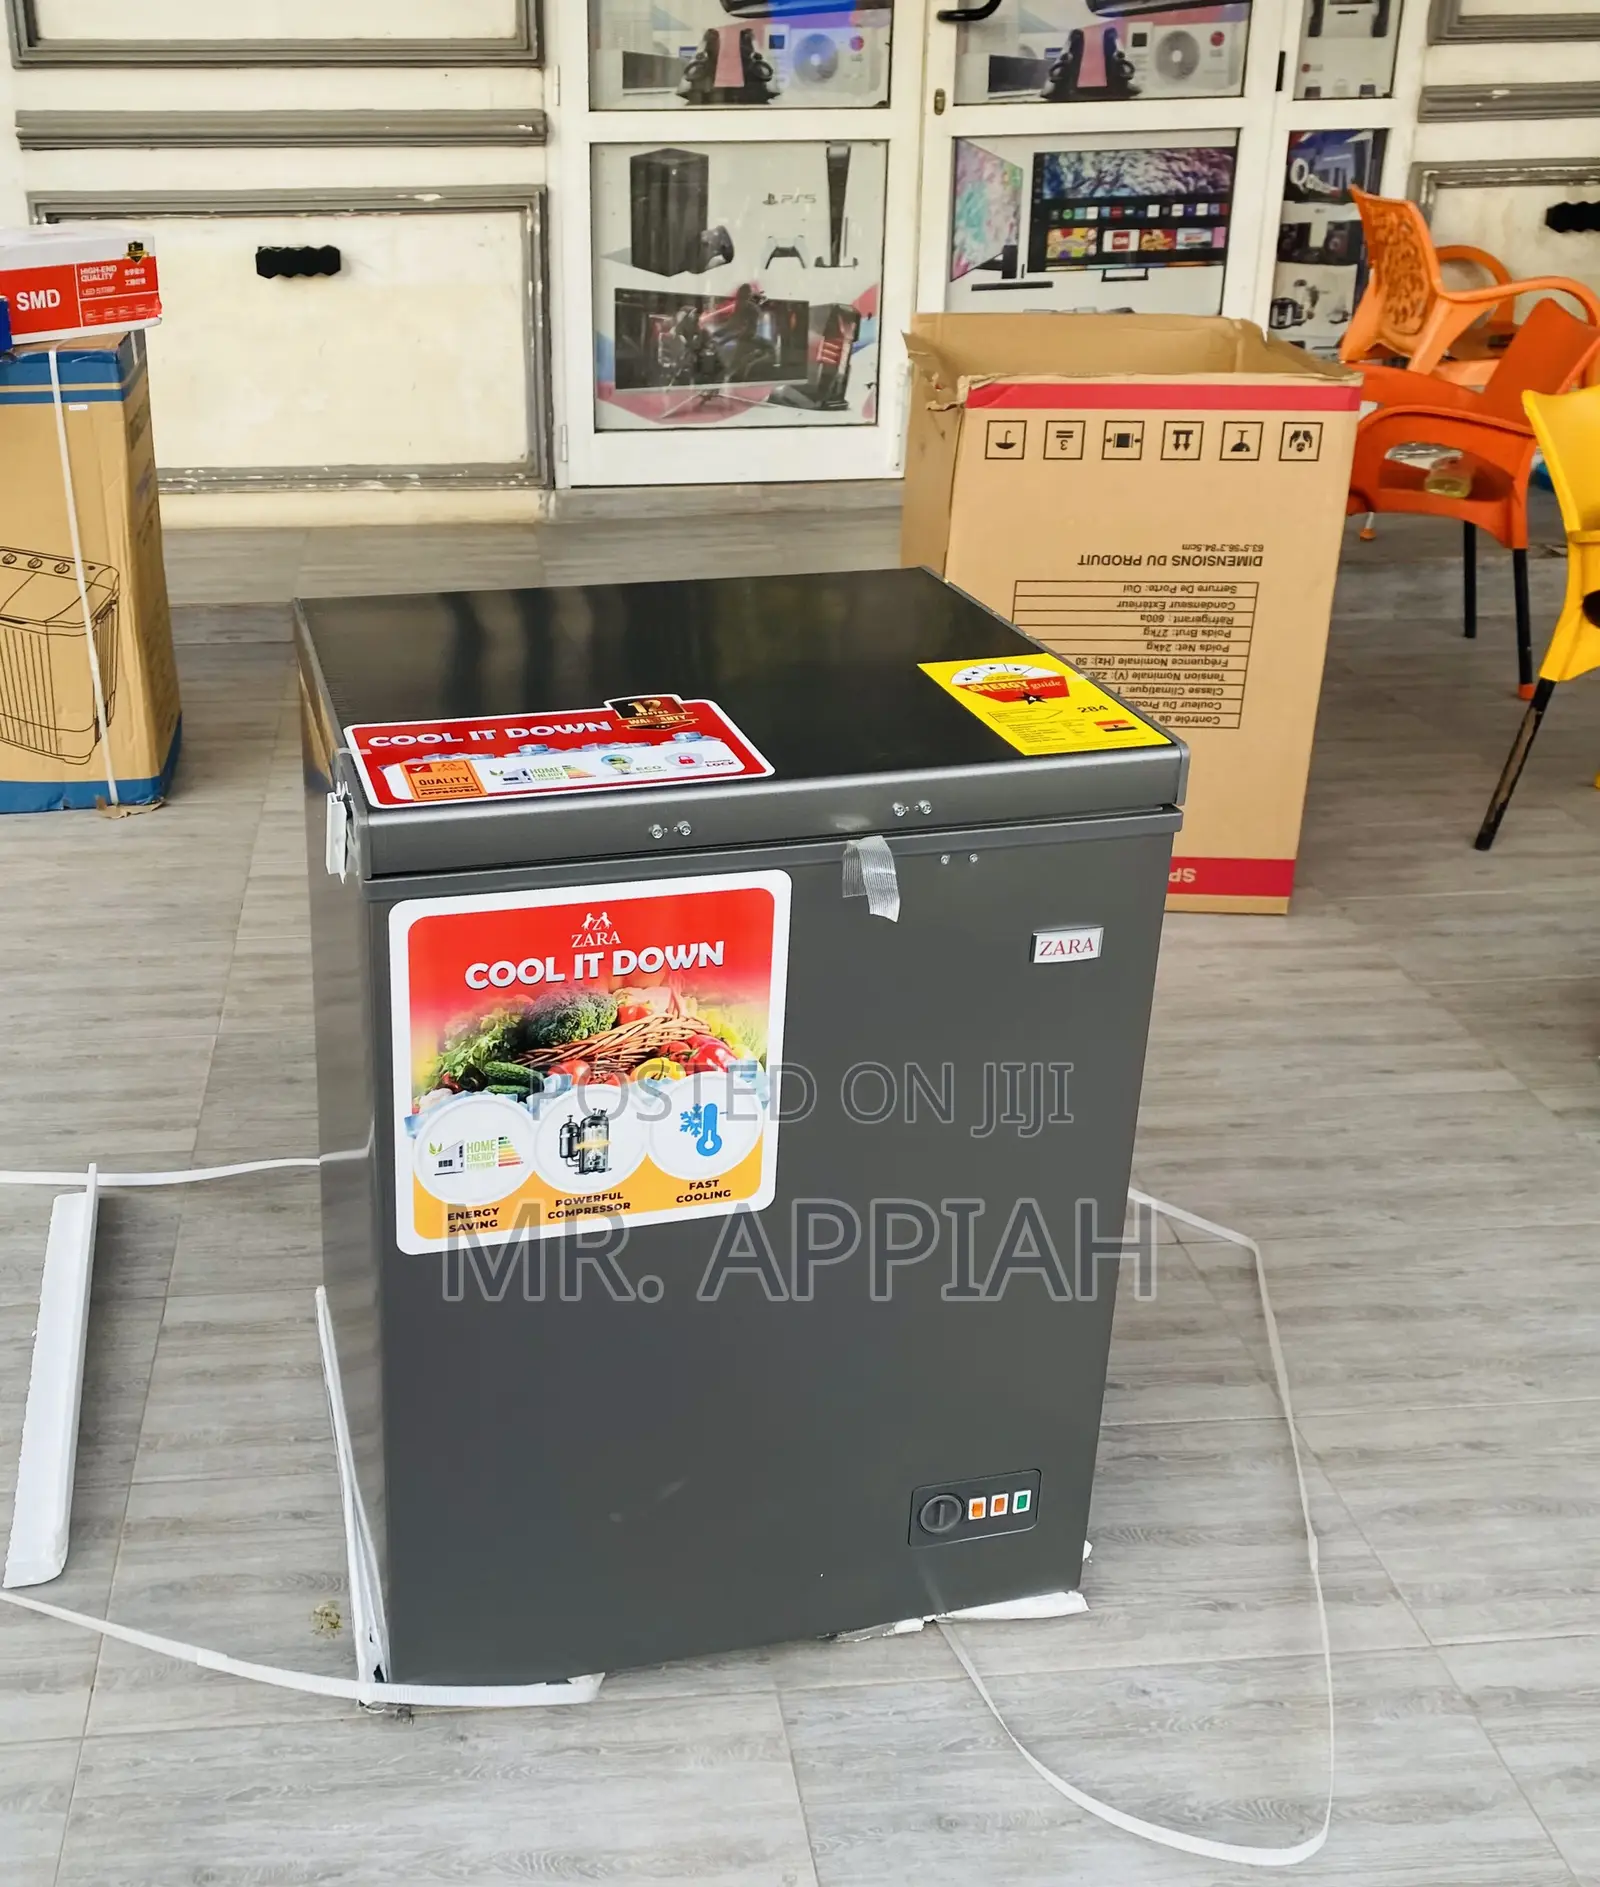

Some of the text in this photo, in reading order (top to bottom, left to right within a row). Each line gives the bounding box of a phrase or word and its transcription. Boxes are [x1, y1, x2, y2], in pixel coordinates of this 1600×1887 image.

[780, 193, 817, 204] PS5
[80, 265, 117, 276] HIGH-END
[80, 273, 114, 282] QUALITY
[16, 289, 61, 312] SMD
[1077, 554, 1264, 567] DIMENSIONS DU PRODUIT
[1123, 584, 1238, 594] Serrure De Porte: Oui
[1169, 601, 1236, 610] Condenseur
[1143, 628, 1231, 638] Poids Brut: 27kg
[1146, 643, 1230, 652] Poids Net: 24kg
[1076, 657, 1087, 666] 50
[1118, 657, 1168, 667] Nominale
[1171, 658, 1229, 667] Fréquence
[1131, 672, 1181, 681] Nominale
[1184, 673, 1225, 681] Tension
[1030, 680, 1062, 690] guide
[1126, 686, 1185, 695] Climatique:
[1189, 687, 1224, 695] Classe
[628, 699, 662, 713] 12
[1133, 700, 1222, 710] Couleur Du Prod
[1158, 716, 1172, 724] de
[1174, 716, 1221, 725] Contrôle
[368, 720, 613, 747] COOL IT DOWN
[418, 776, 470, 787] QUALITY
[420, 787, 479, 796] APPROVED
[571, 931, 622, 948] ZARA
[1039, 937, 1094, 956] ZARA
[464, 940, 725, 991] COOL IT DOWN
[466, 1139, 497, 1153] HOME
[466, 1152, 496, 1163] ENERGY
[689, 1179, 720, 1190] FAST
[555, 1192, 624, 1207] POWERFUL
[676, 1189, 732, 1204] COOLING
[448, 1207, 500, 1221] ENERGY
[547, 1202, 631, 1219] COMPRESSOR
[448, 1219, 498, 1233] SAVING
